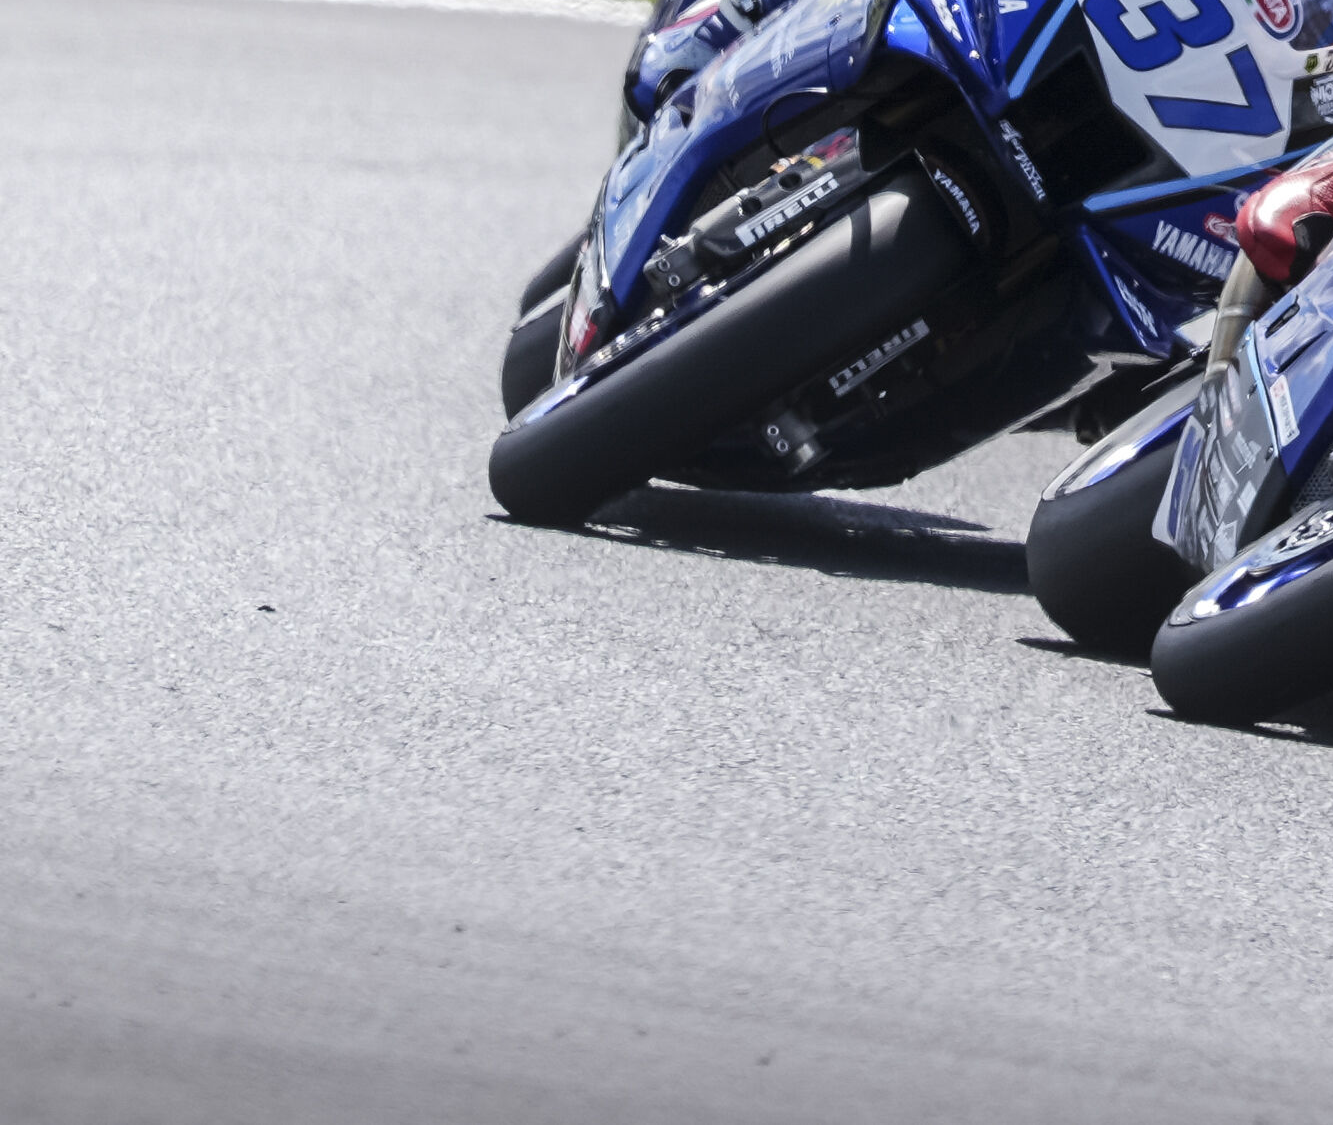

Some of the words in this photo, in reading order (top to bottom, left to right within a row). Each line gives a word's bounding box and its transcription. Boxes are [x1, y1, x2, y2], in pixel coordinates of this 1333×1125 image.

[735, 171, 839, 248] PIRELLI
[935, 168, 981, 236] YAMAHA
[1152, 219, 1236, 281] YAMAHA
